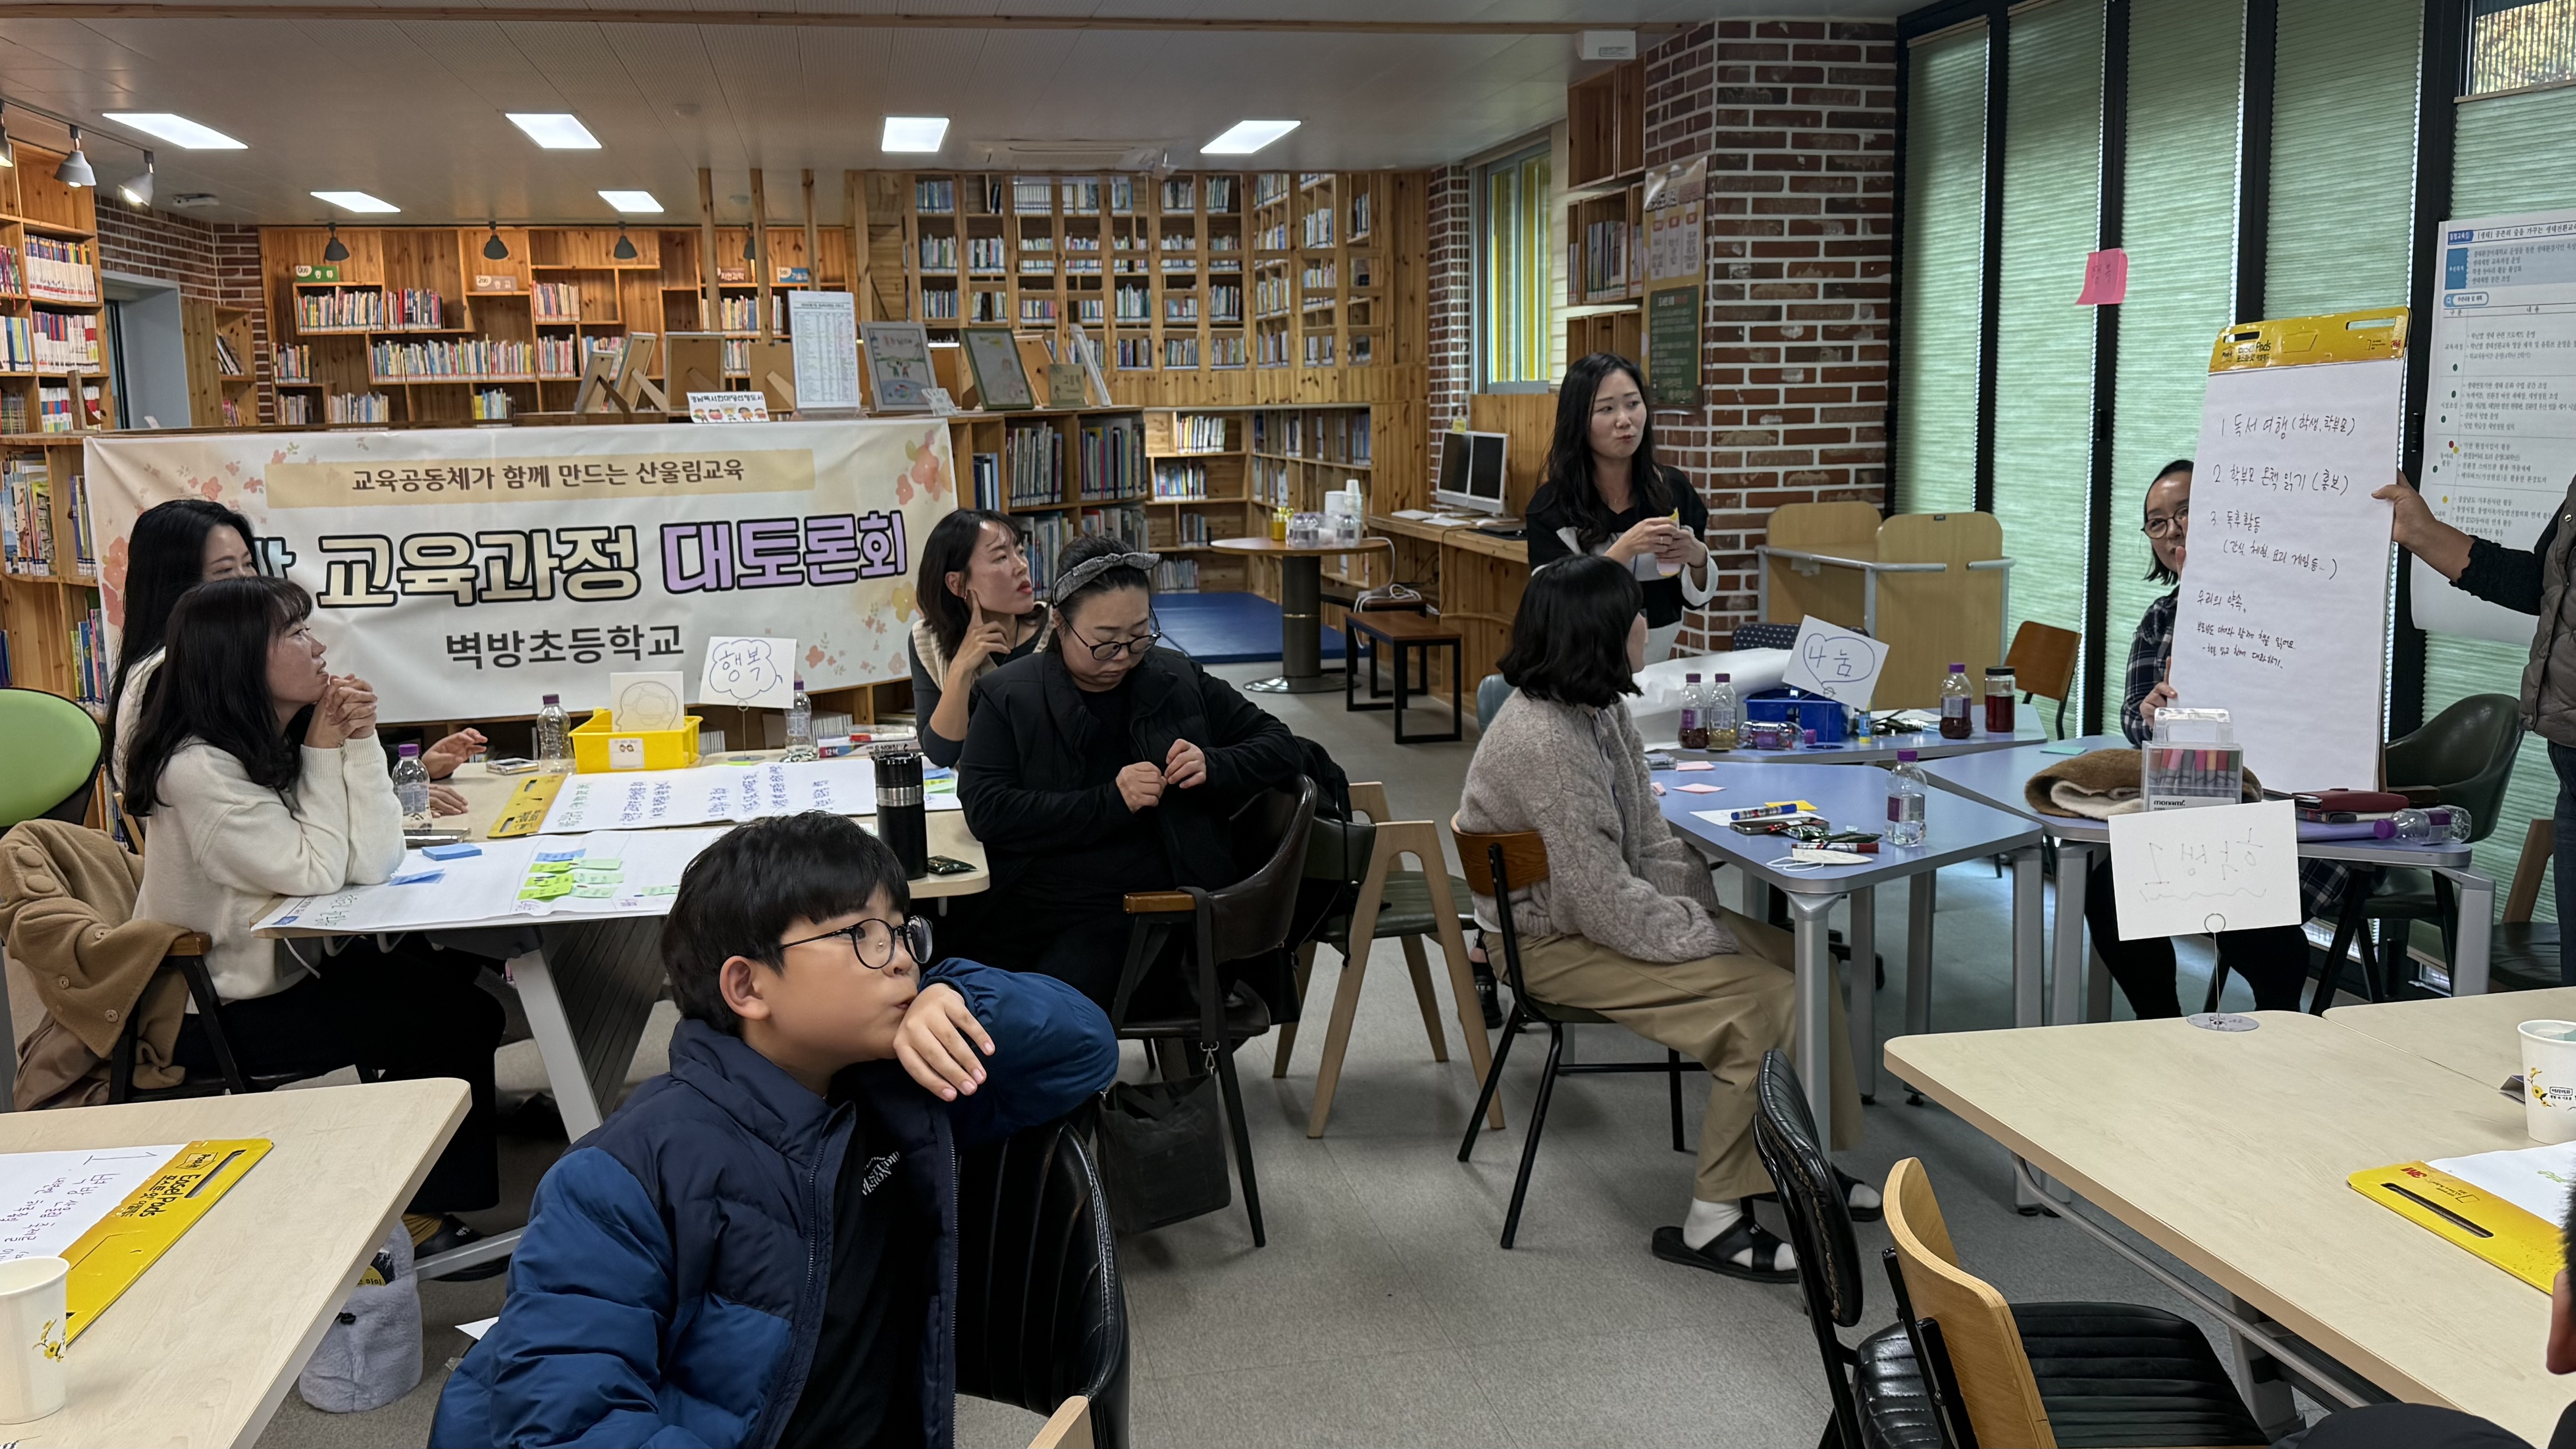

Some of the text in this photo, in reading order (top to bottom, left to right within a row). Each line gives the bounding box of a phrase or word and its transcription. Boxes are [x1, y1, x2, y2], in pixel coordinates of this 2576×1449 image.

[2256, 340, 2271, 352] Pads
[2234, 413, 2258, 437] 독서
[2262, 416, 2288, 440] 여행
[352, 459, 744, 492] 교육공동체가 함께 만드는 산울림교육
[2284, 471, 2306, 492] 읽기
[316, 525, 642, 608] 교육과정
[660, 510, 907, 594] 대토론회
[2197, 589, 2222, 606] 우리의
[446, 624, 685, 670] 벽방초등학교
[719, 646, 764, 684] 행복
[1808, 645, 1851, 678] 나눔
[162, 1173, 201, 1196] Easel
[139, 1196, 178, 1218] Pads
